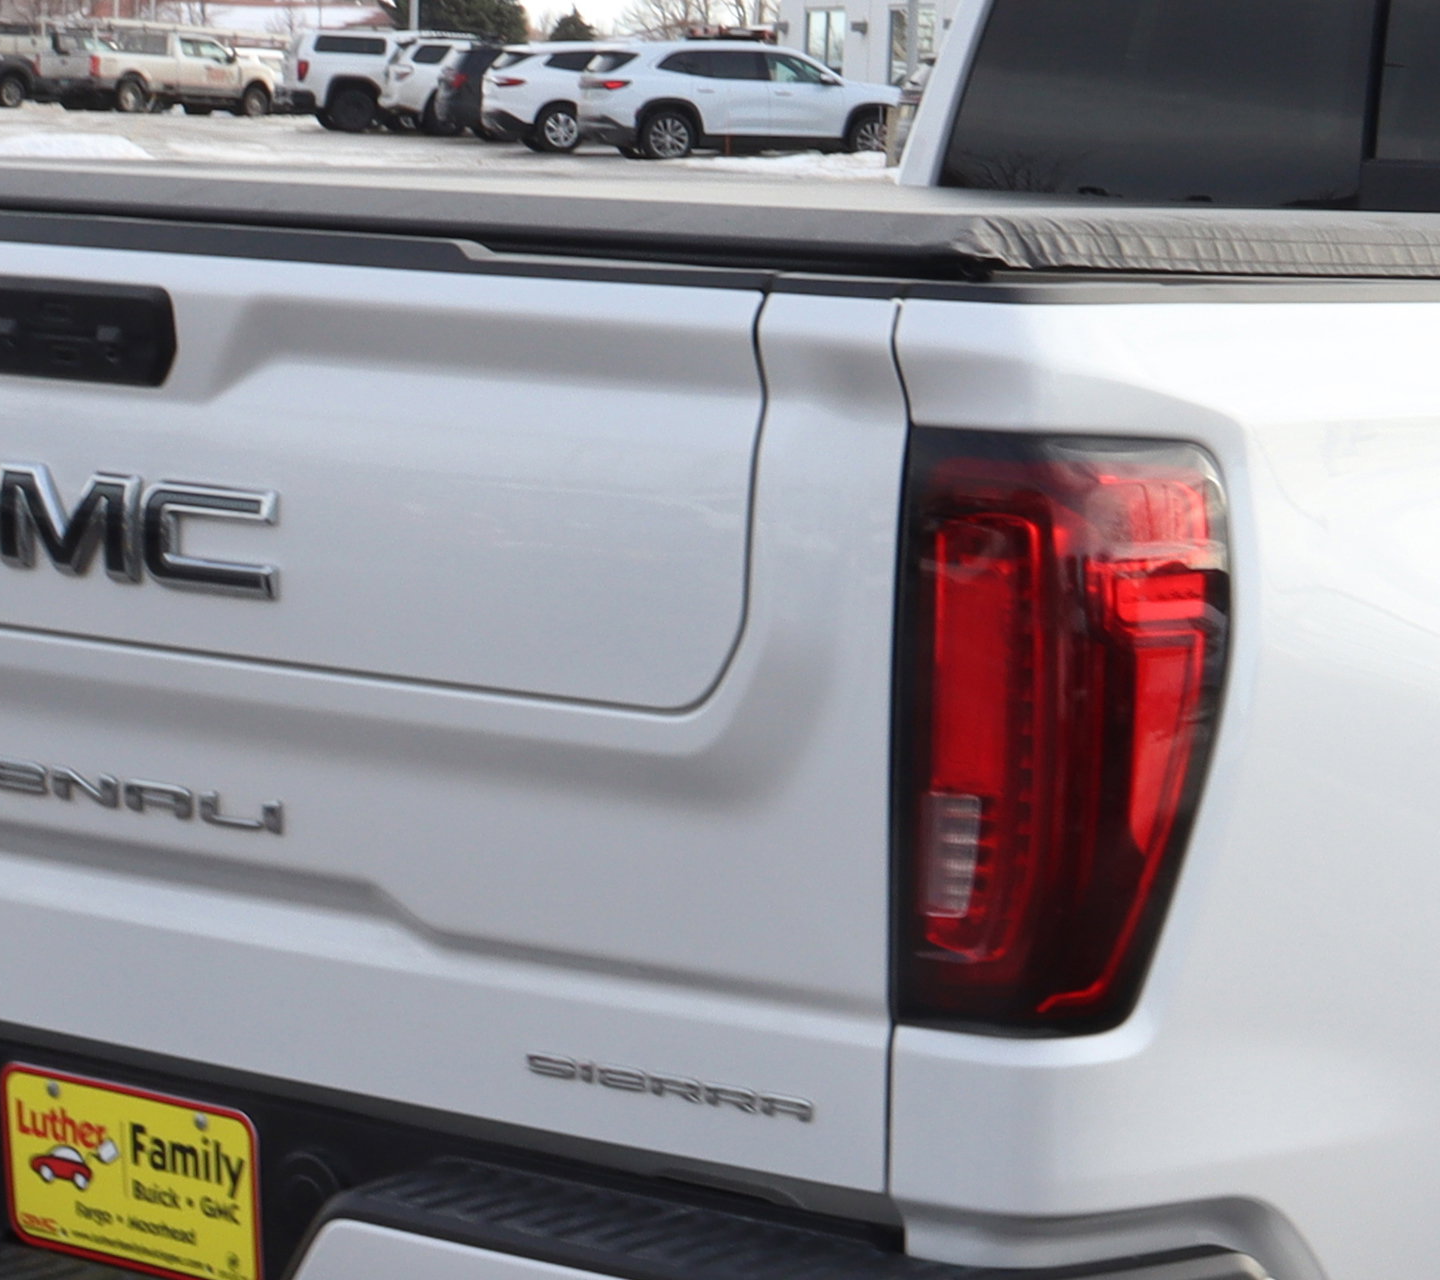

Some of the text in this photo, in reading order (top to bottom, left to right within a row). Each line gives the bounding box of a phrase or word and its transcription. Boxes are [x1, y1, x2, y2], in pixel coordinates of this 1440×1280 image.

[525, 1052, 813, 1123] SIERRA
[15, 1098, 245, 1200] Luther Family
[132, 1179, 182, 1211] Buick
